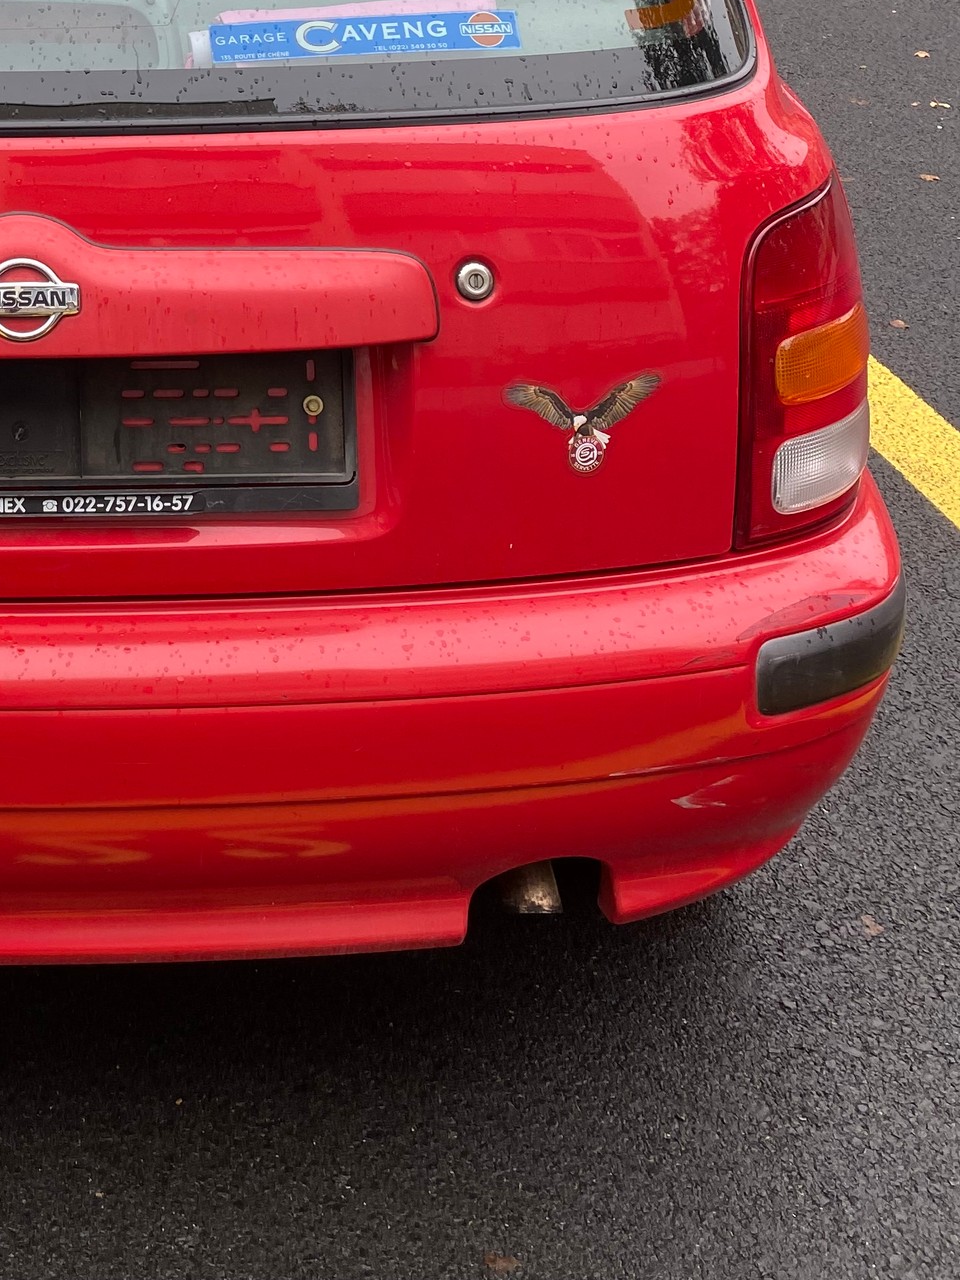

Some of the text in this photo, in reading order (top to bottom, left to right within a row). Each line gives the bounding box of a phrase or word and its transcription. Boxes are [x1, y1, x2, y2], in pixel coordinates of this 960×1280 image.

[461, 23, 512, 34] NISSAN
[215, 19, 448, 54] GARAGE CAVENG
[574, 460, 600, 471] SERVETTE
[62, 495, 194, 513] 022-757-16-57
